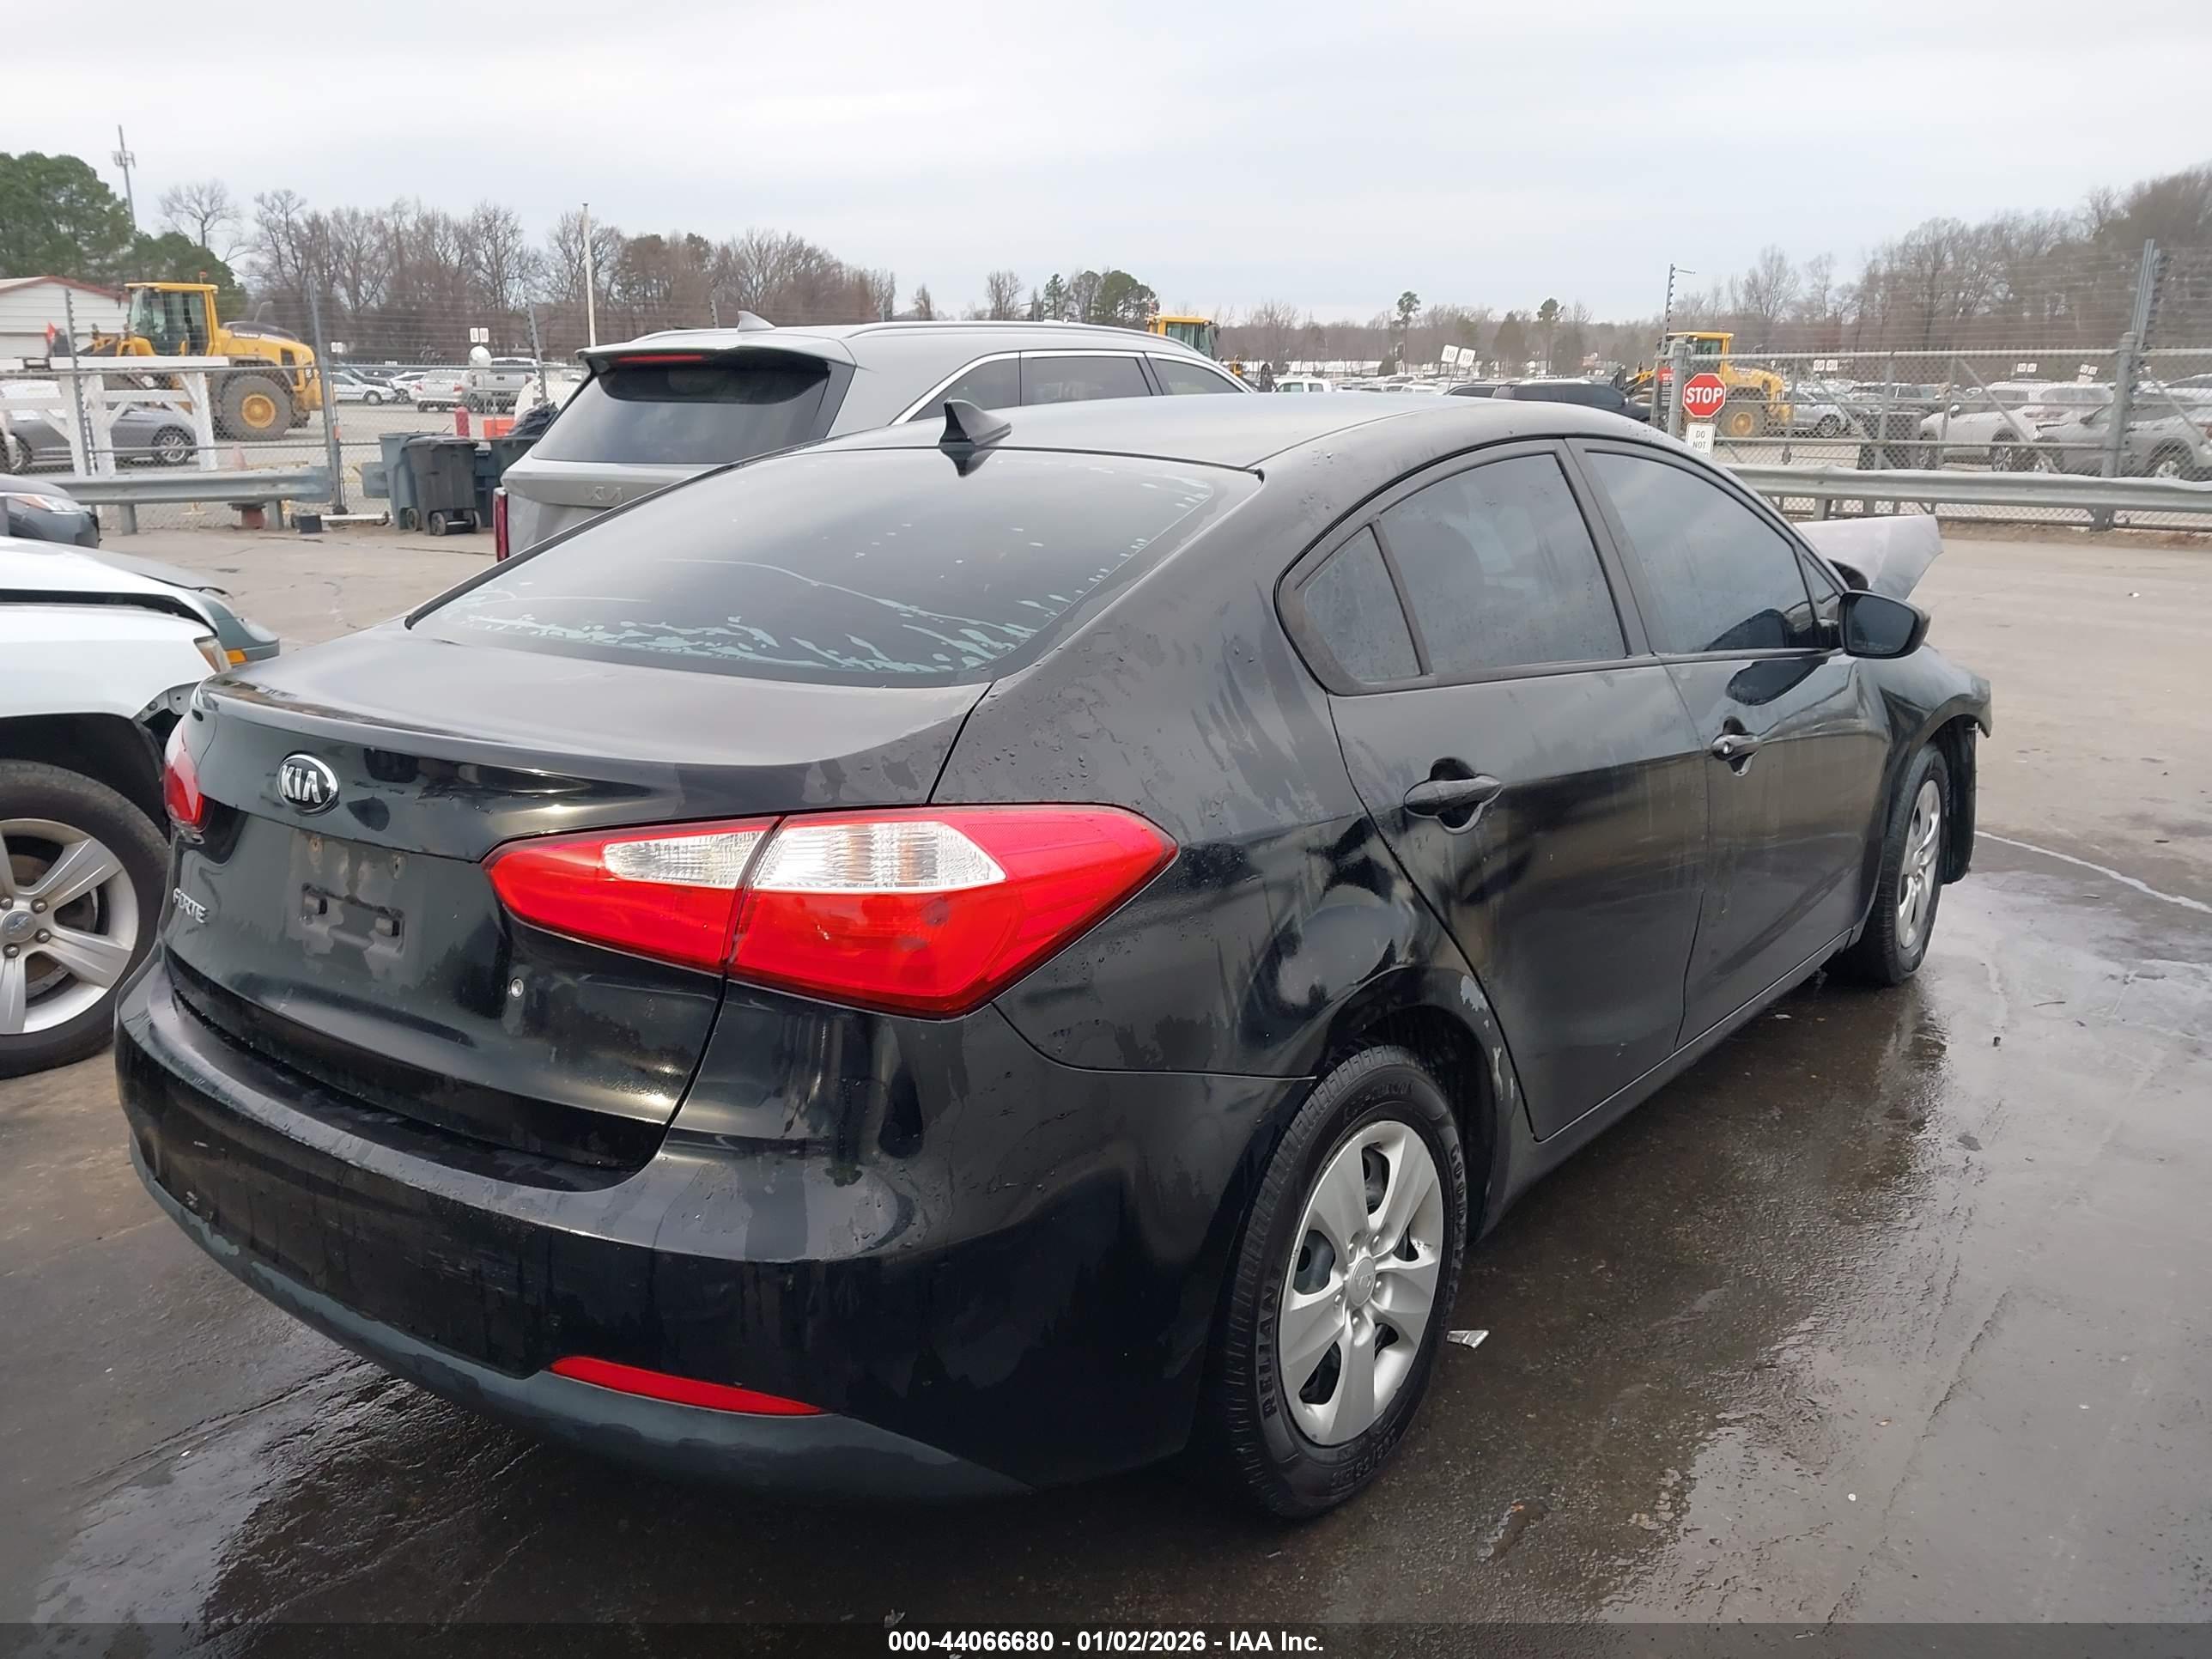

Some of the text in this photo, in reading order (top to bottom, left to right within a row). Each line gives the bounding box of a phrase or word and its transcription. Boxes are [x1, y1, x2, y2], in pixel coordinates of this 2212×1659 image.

[1445, 349, 1455, 359] 10
[1462, 352, 1472, 362] 10
[1686, 386, 1723, 404] STOP
[1692, 441, 1706, 449] NOT
[280, 764, 322, 804] KIA
[173, 887, 207, 924] FORTE
[1257, 1263, 1283, 1420] RELIANT
